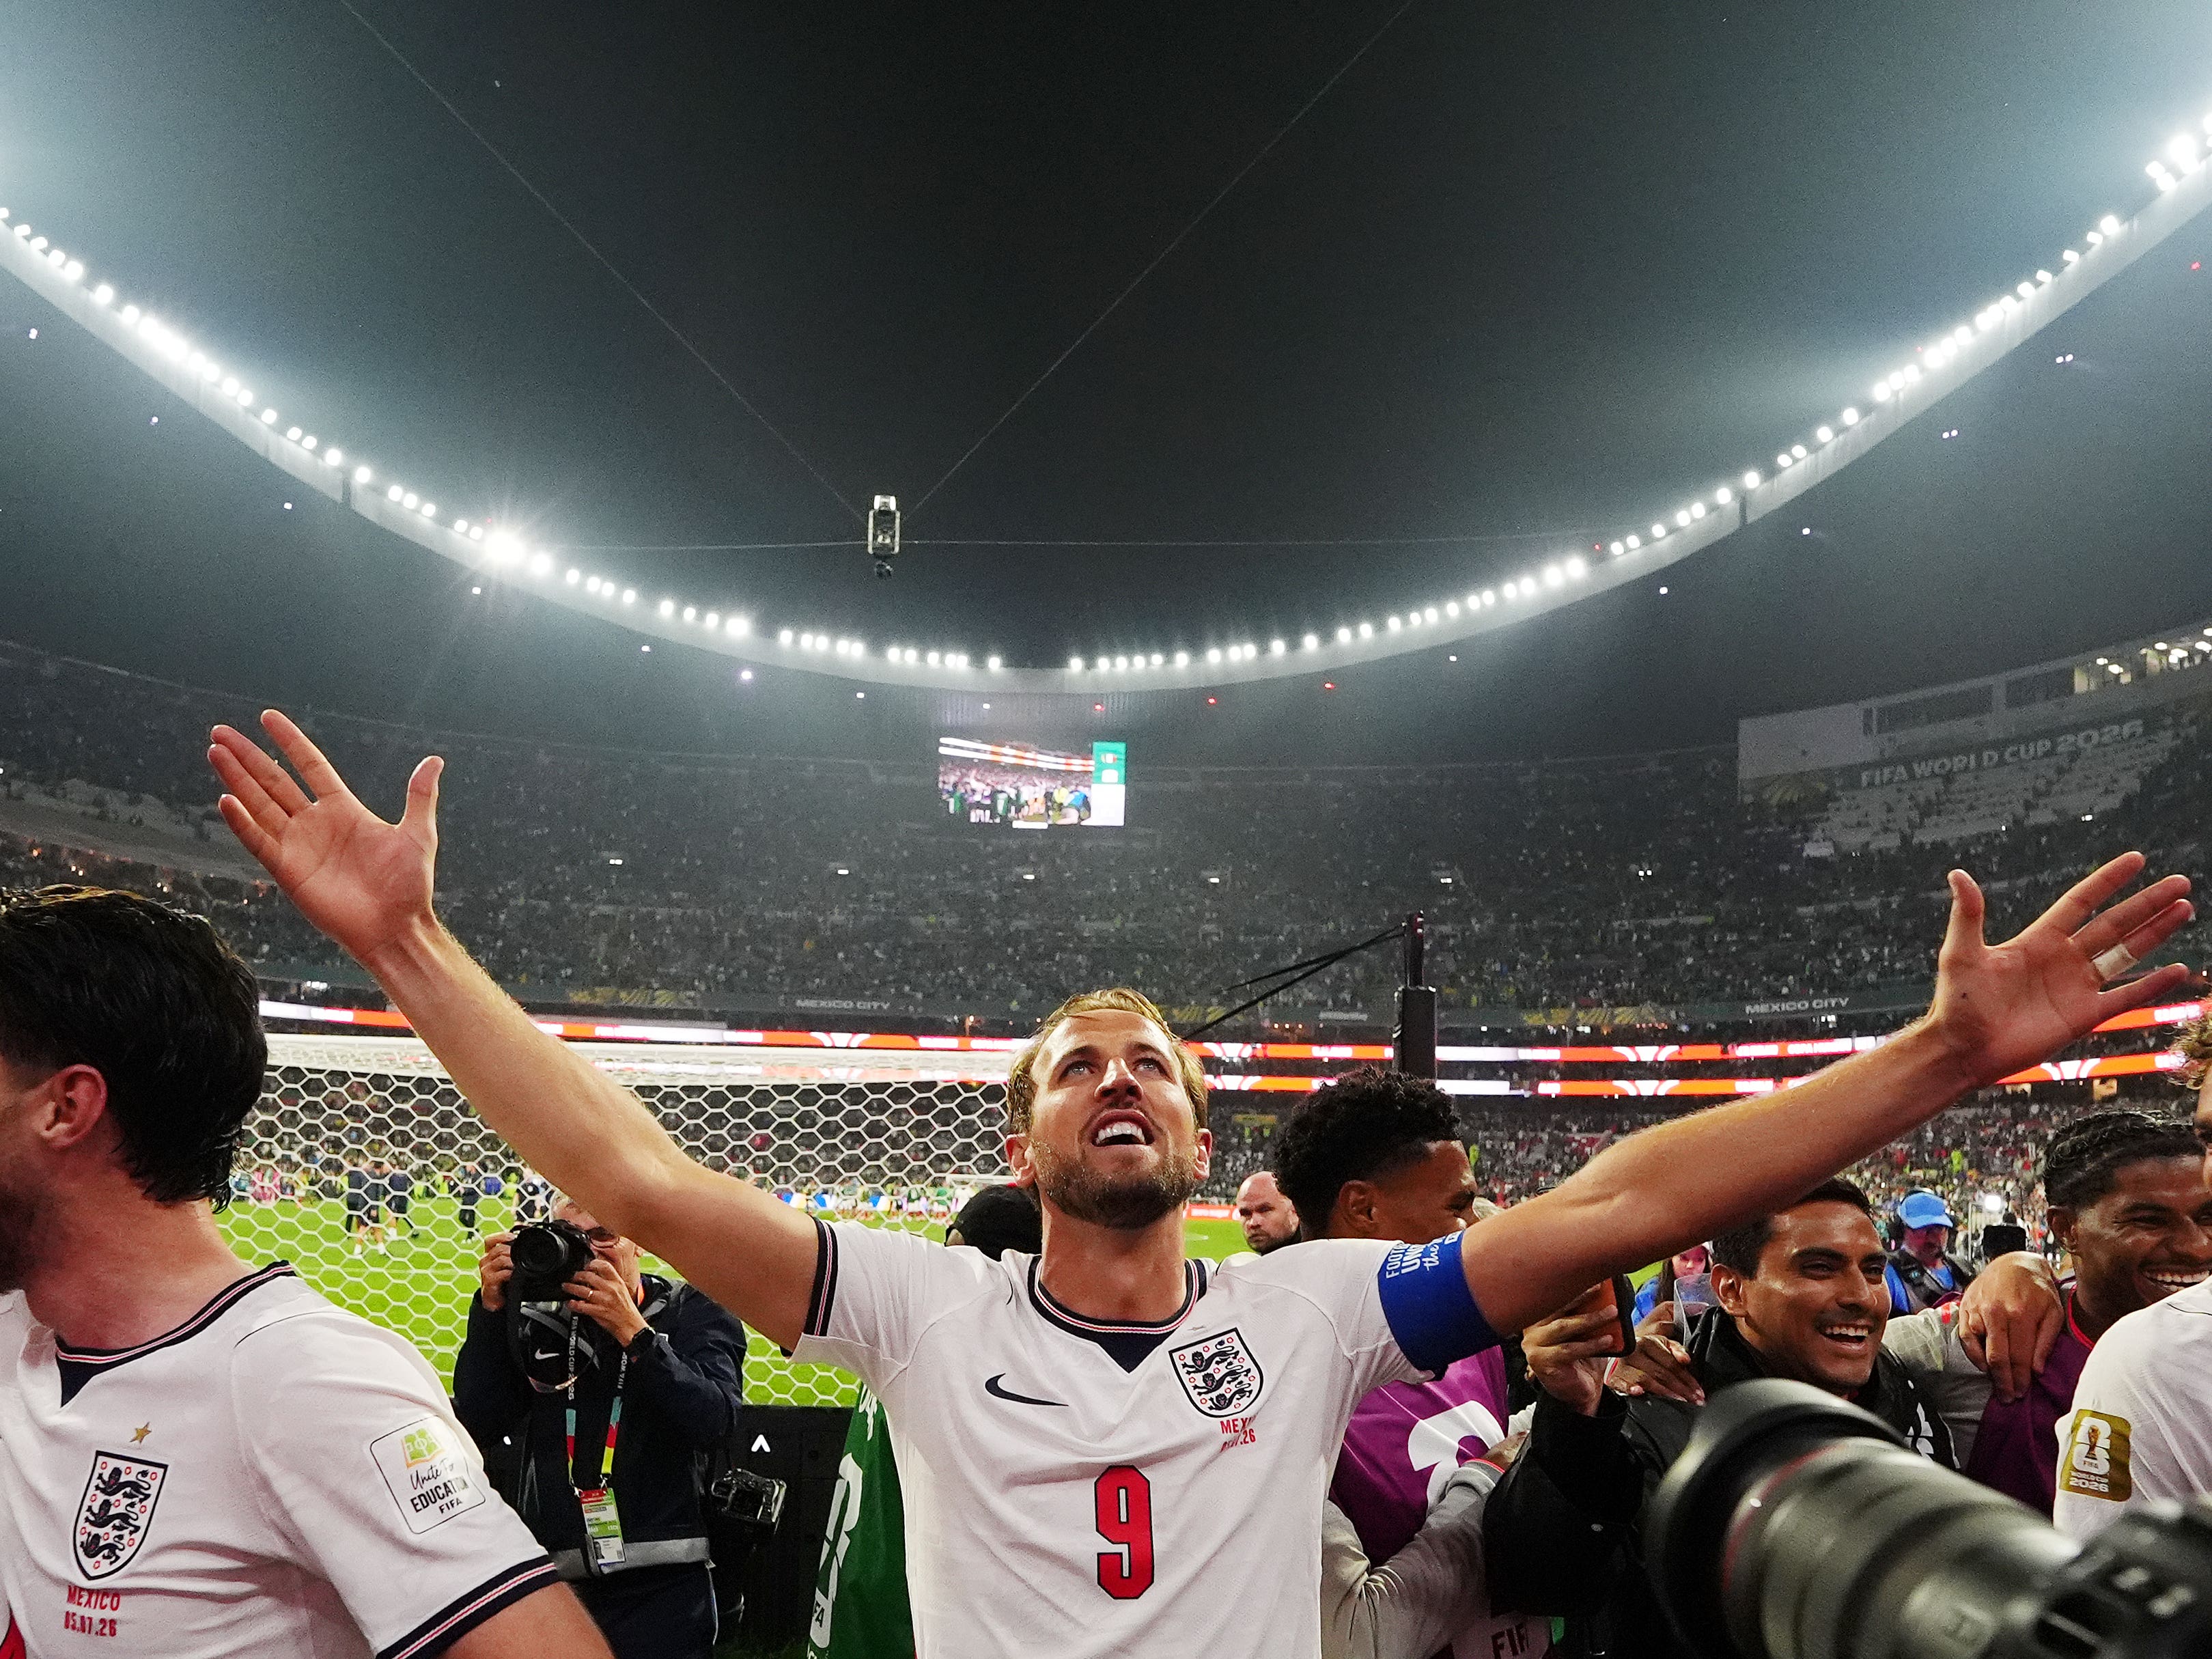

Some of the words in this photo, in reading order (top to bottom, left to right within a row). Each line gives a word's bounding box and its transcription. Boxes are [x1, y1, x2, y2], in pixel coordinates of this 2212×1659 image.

[1861, 764, 1908, 787] FIFA
[1912, 750, 1999, 780] WORLD
[2004, 738, 2052, 764] CUP
[2056, 719, 2143, 752] 2026
[796, 999, 854, 1008] MEXICO
[856, 1001, 891, 1009] CITY
[1745, 1000, 1809, 1014] MEXICO
[1812, 996, 1850, 1009] CITY
[1422, 1244, 1439, 1271] the
[569, 1330, 577, 1356] WORLD
[410, 1464, 442, 1490] Unite
[2069, 1477, 2110, 1492] 2026
[438, 1498, 463, 1514] FIFA
[1094, 1465, 1154, 1600] 9
[66, 1585, 120, 1611] MEXICO
[1491, 1623, 1529, 1659] FIF
